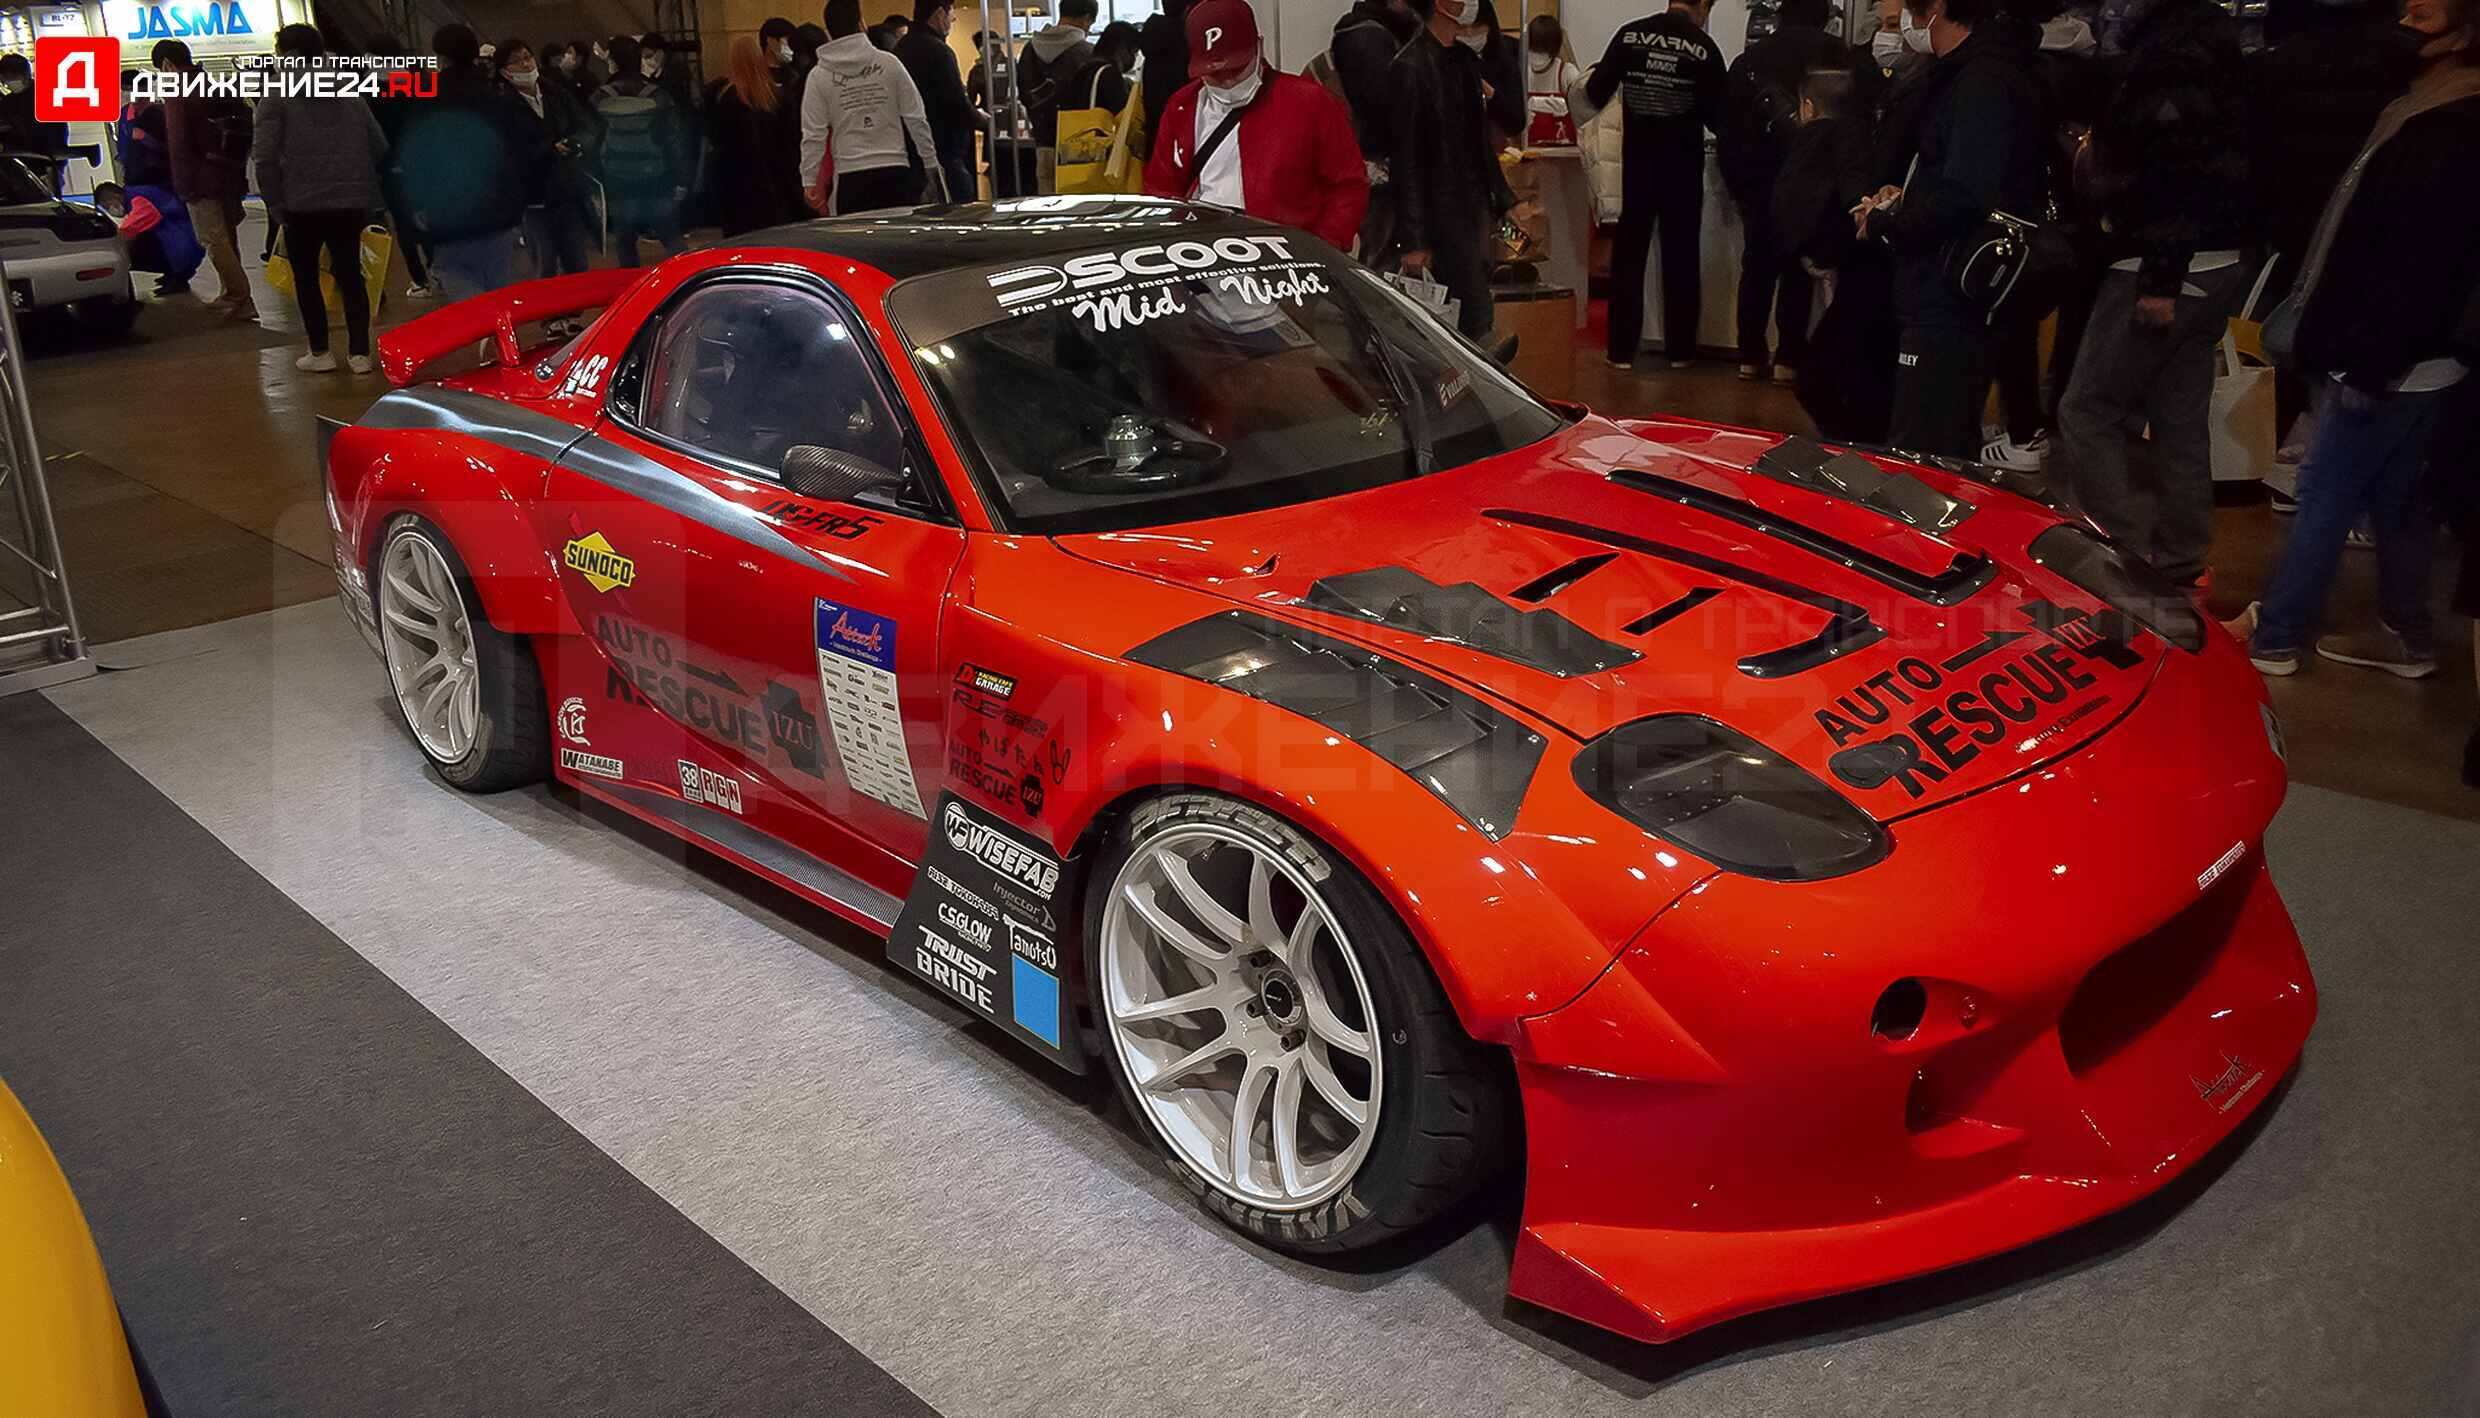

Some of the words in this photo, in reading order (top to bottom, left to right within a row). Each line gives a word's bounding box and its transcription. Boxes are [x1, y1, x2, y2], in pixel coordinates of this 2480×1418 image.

[128, 2, 254, 40] JASMA
[1205, 27, 1222, 50] P
[1008, 302, 1048, 317] The
[1051, 291, 1096, 306] best
[1100, 283, 1135, 298] and
[1138, 275, 1183, 290] most
[1185, 266, 1256, 283] effective
[1072, 286, 1186, 333] Mid
[1220, 268, 1330, 307] Night
[566, 541, 633, 585] SUNOCO
[597, 614, 673, 666] AUTO
[606, 660, 769, 757] RESCUE
[975, 677, 1012, 696] GARAGE
[1814, 657, 1943, 747] AUTO
[774, 713, 817, 753] IZU
[1888, 643, 2097, 800] RESCUE
[563, 750, 621, 773] WATANABE
[682, 766, 698, 788] 38
[950, 757, 1019, 806] RESCUE
[969, 824, 1060, 893] WISEFAB
[993, 881, 1040, 914] Injector
[918, 924, 998, 982] TRUST
[916, 946, 995, 1014] BRIDE
